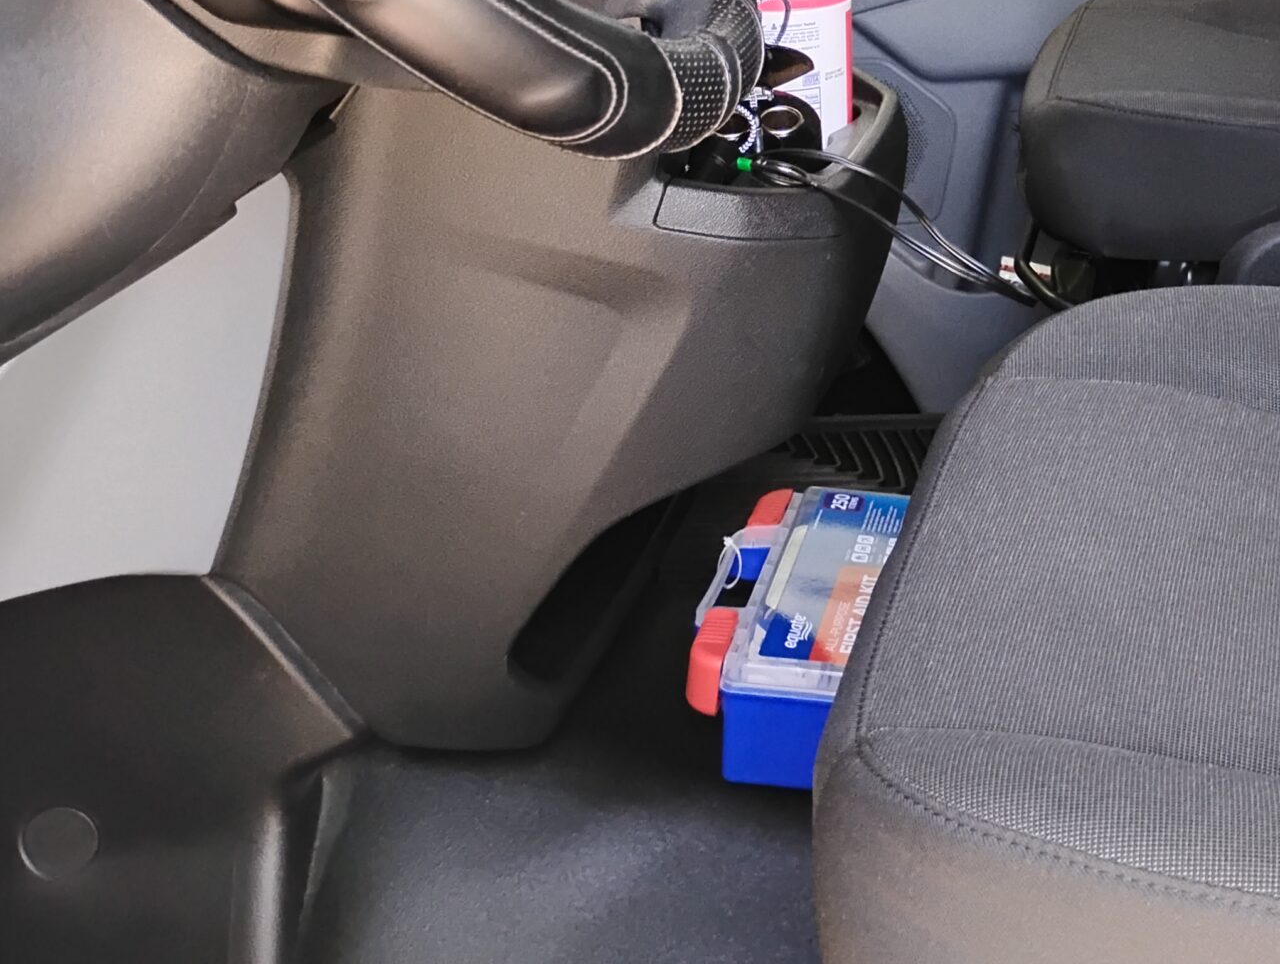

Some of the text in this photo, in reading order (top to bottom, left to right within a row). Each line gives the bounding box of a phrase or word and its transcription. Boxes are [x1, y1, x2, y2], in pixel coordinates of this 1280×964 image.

[831, 493, 850, 511] 250
[859, 574, 878, 596] KIT
[784, 612, 807, 649] equate
